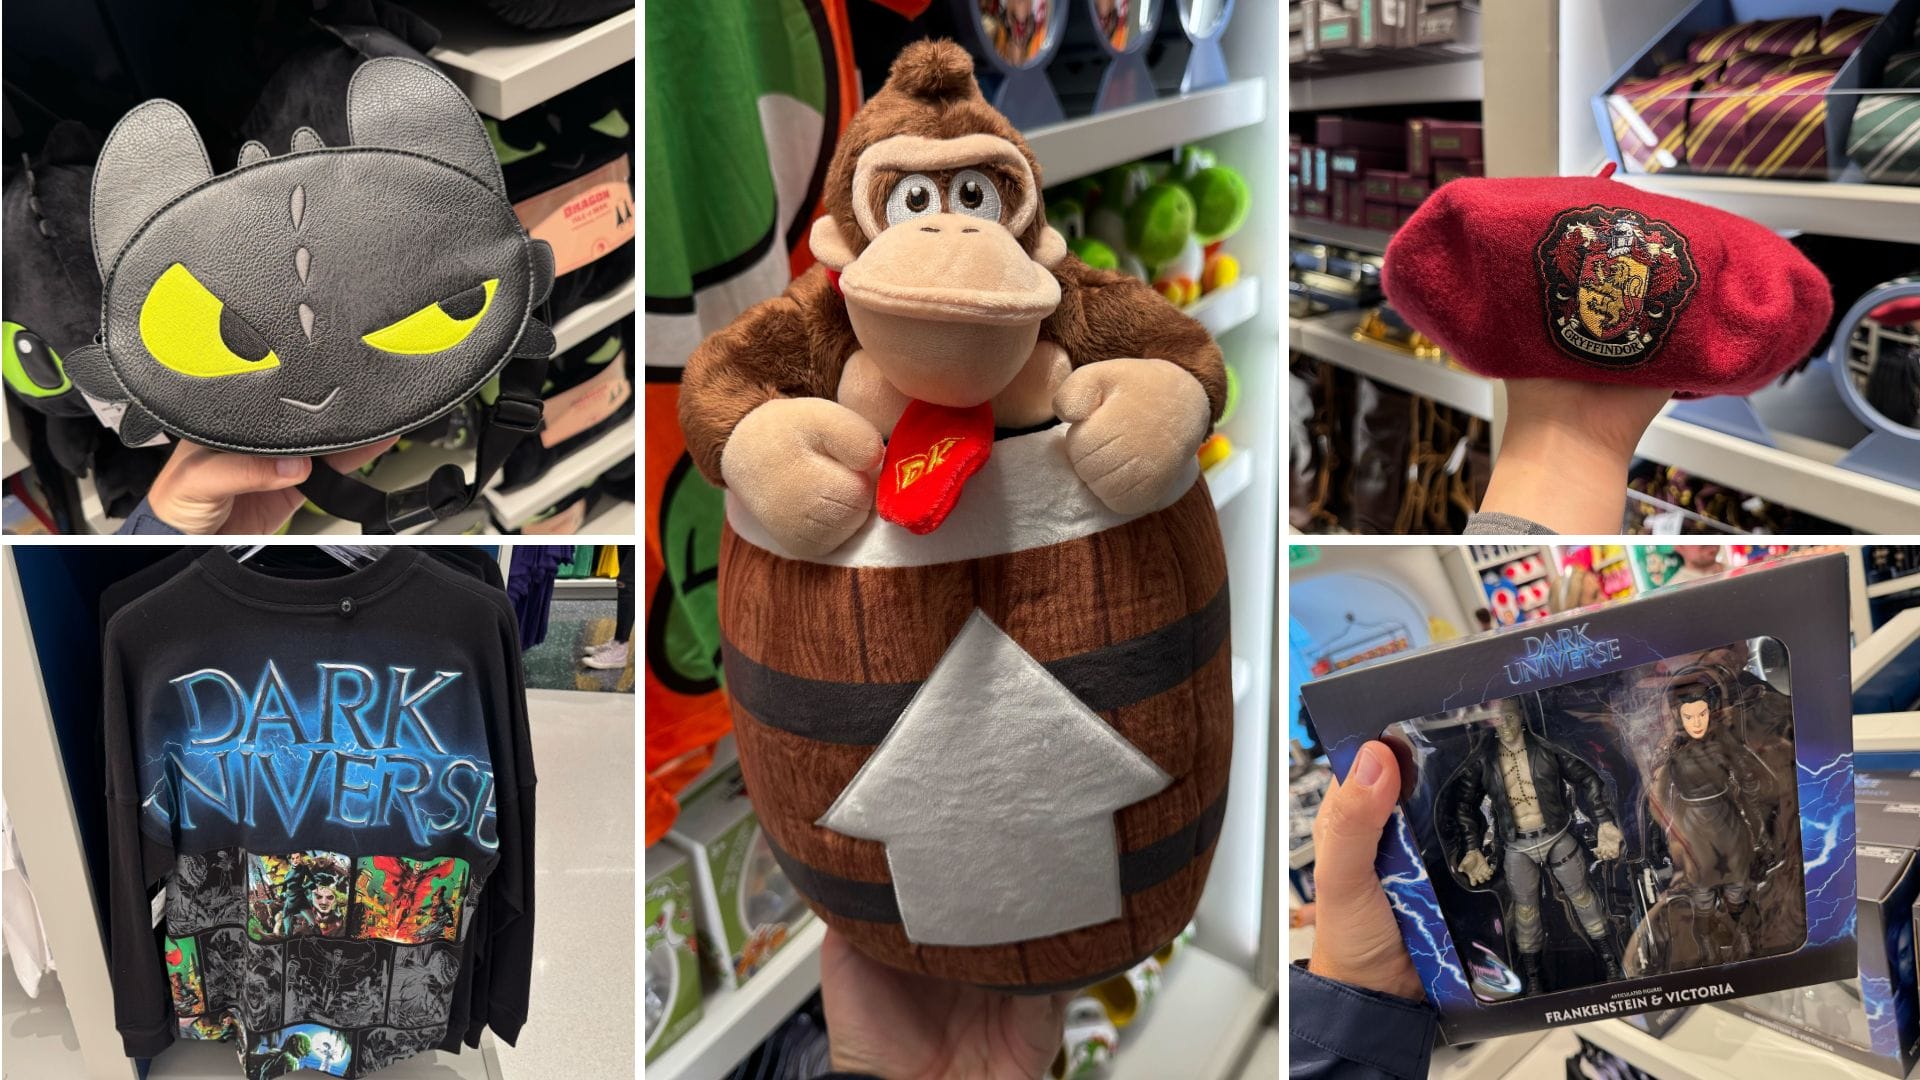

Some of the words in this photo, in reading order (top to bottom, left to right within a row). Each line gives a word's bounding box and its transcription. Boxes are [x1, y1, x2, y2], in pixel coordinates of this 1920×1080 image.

[563, 190, 610, 219] DRAGON
[1564, 328, 1641, 355] GRYFFINDOR
[897, 437, 963, 493] DK
[1523, 622, 1595, 658] DARK
[1503, 638, 1622, 685] UNIVERSE
[169, 658, 463, 756] DARK
[1545, 996, 1648, 1024] FRANKENSTEIN
[1651, 994, 1663, 1006] &
[1665, 982, 1735, 1003] VICTORIA
